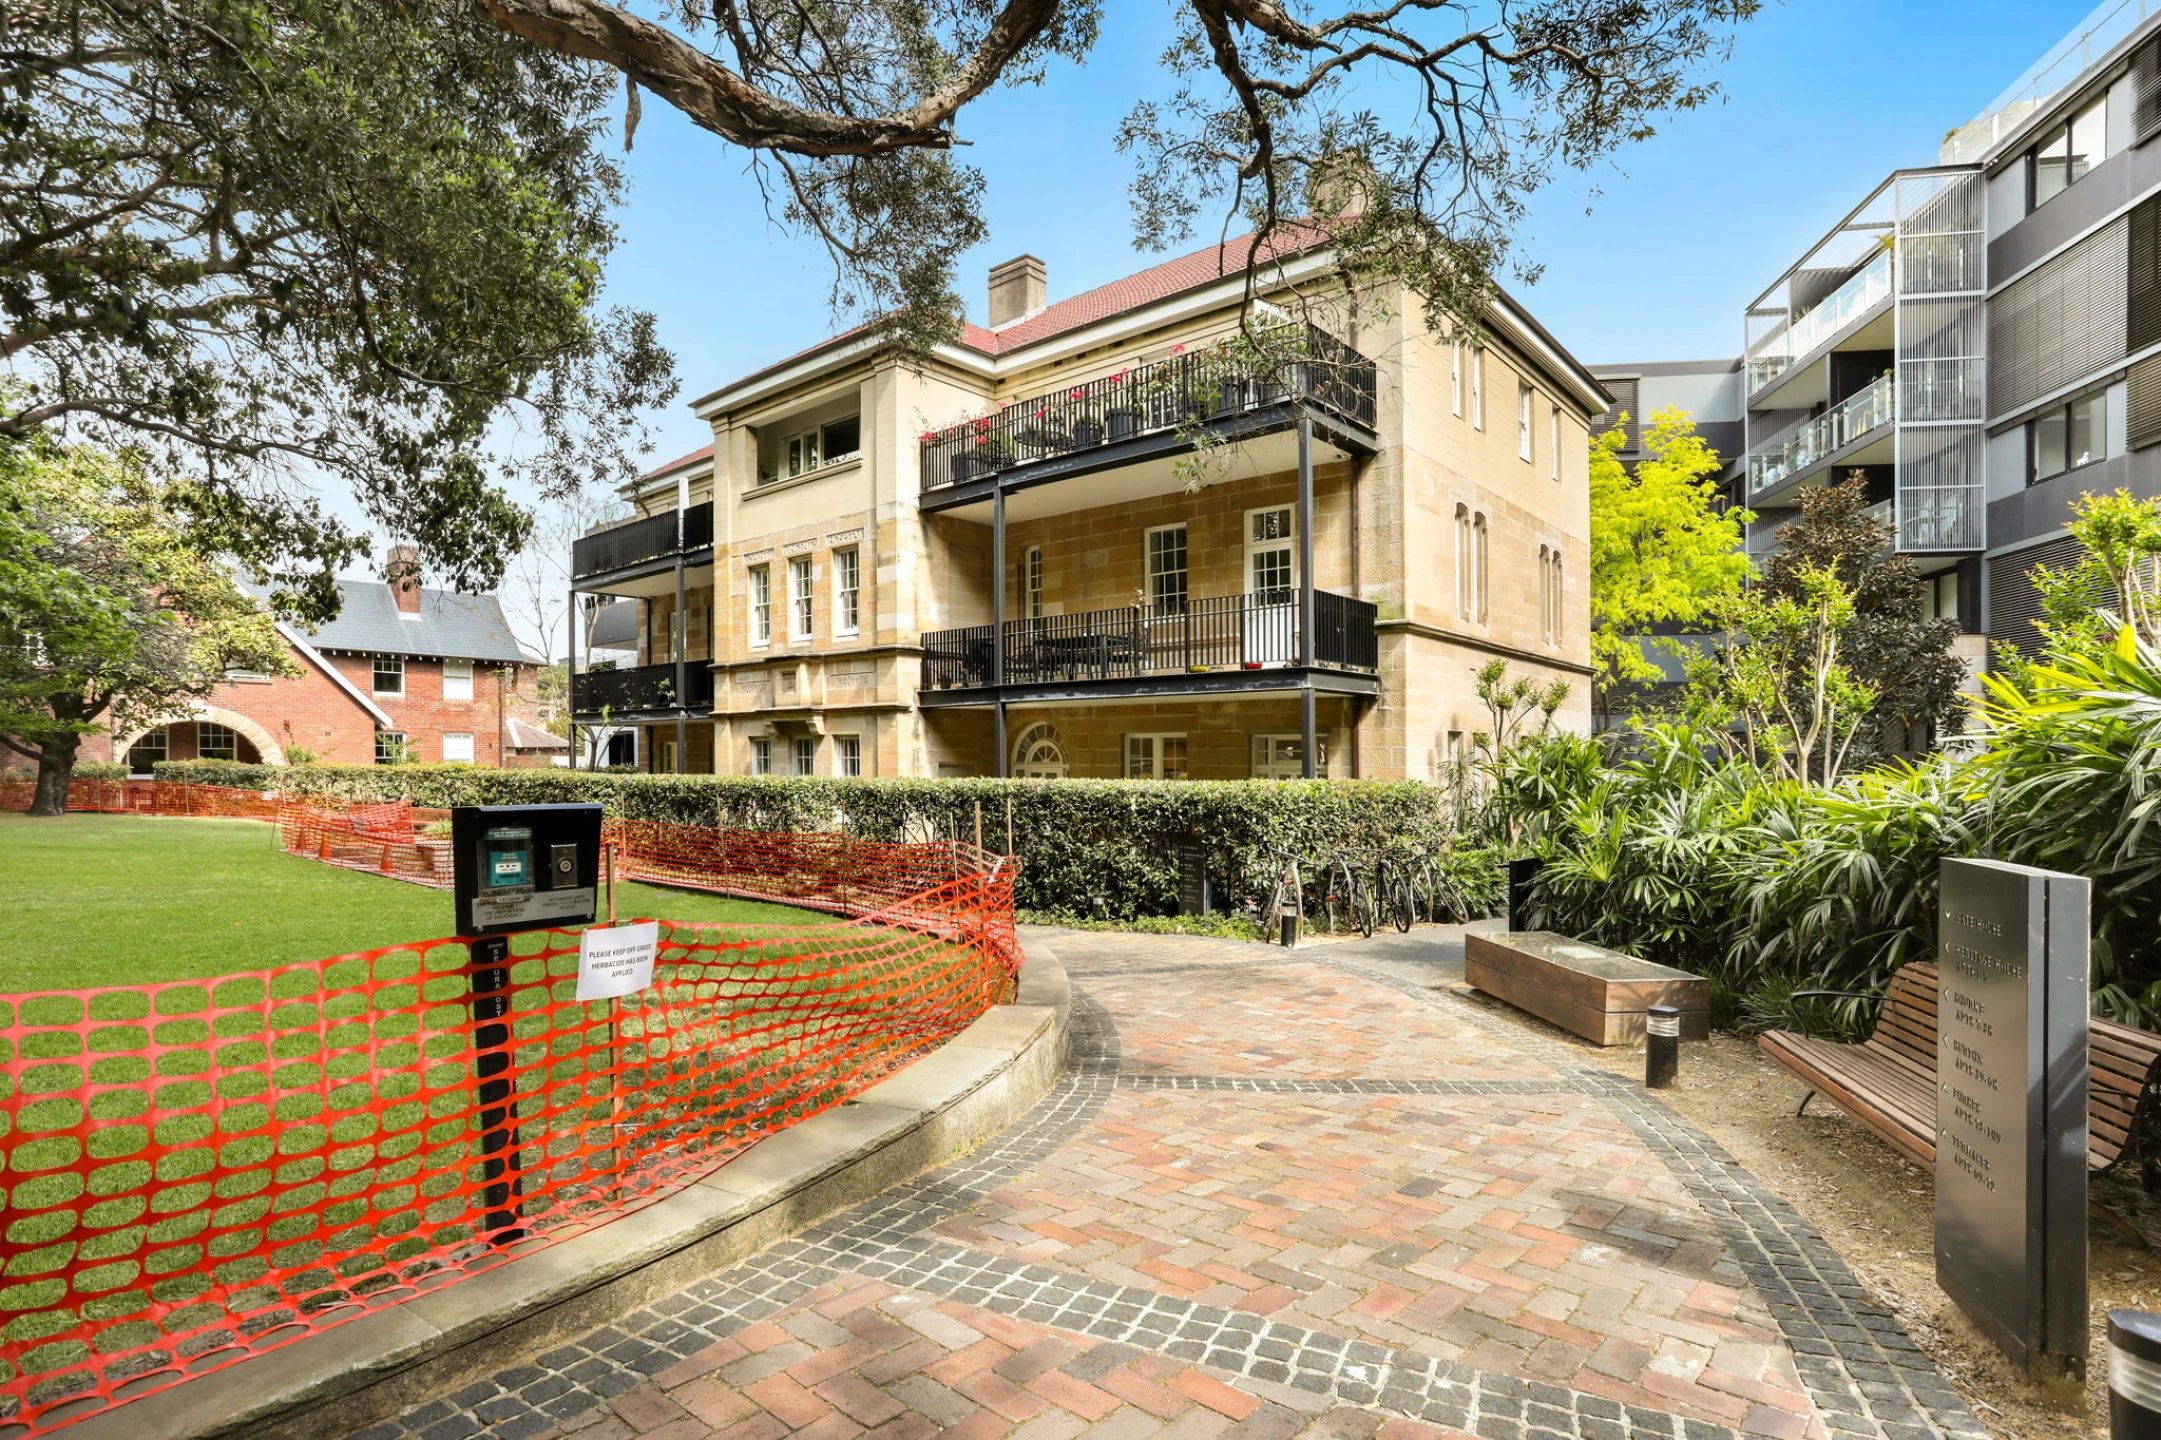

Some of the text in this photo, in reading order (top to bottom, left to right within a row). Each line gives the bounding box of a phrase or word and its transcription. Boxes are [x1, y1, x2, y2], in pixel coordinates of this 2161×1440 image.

[836, 675, 868, 687] CENTRE
[1975, 918, 2002, 937] HOUSE
[589, 943, 652, 958] PLEASE KEEP OFF GRASS
[591, 960, 625, 970] HERBACIDE
[636, 955, 649, 963] BEEN
[1955, 944, 2022, 979] HERITAGE HOUSE
[611, 968, 634, 978] APPLIED
[1953, 992, 1985, 1015] BOURKE
[1955, 1010, 1974, 1027] APTS
[1953, 1039, 1984, 1065] BURTON
[1955, 1057, 1974, 1077] APTS
[1952, 1086, 1981, 1114] FORBES
[1954, 1105, 1973, 1125] APTS
[1951, 1134, 1991, 1171] TERRACES
[1953, 1153, 1973, 1174] APTS
